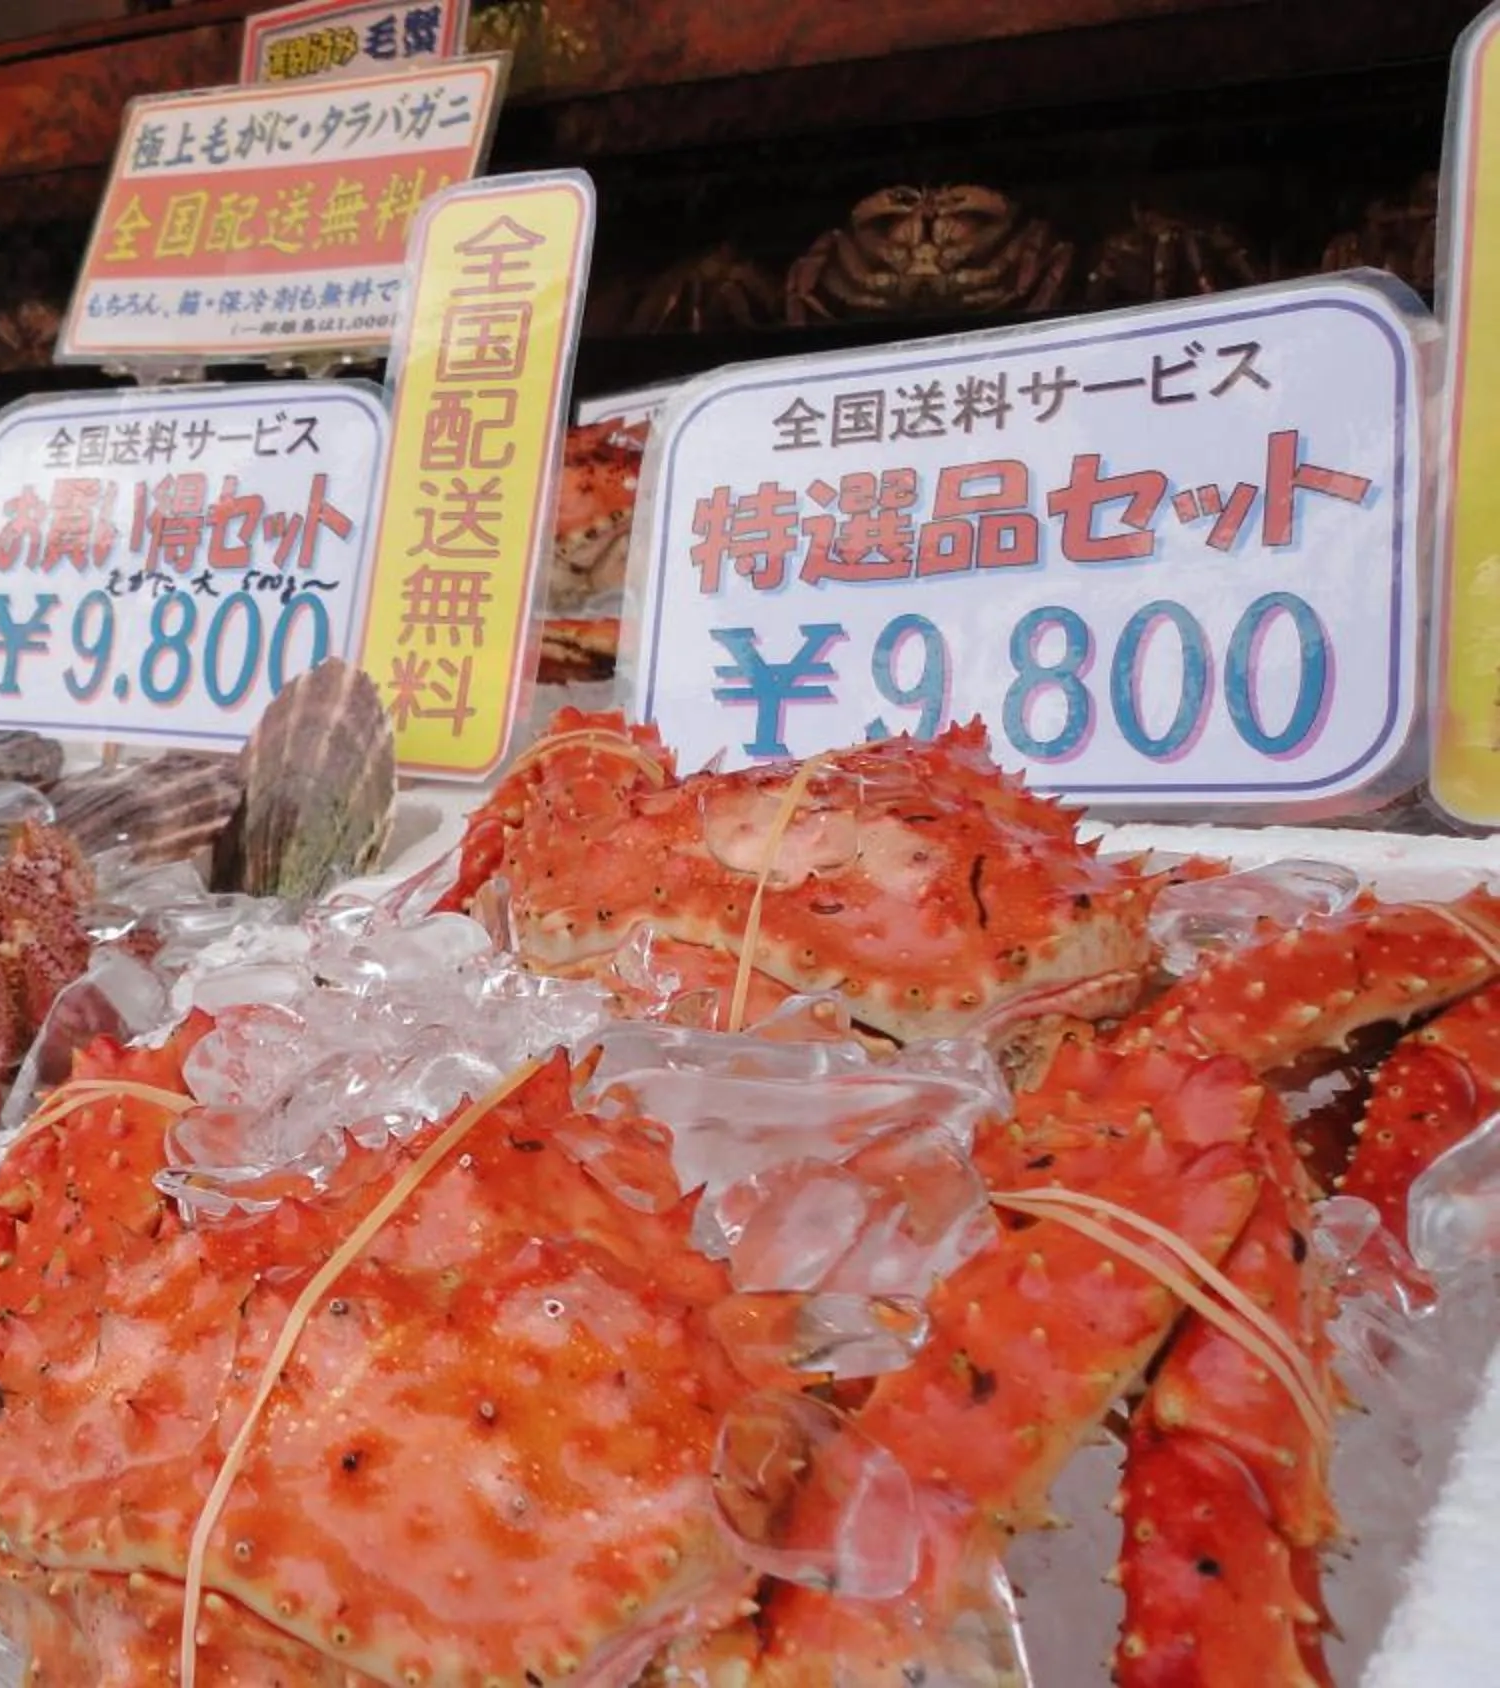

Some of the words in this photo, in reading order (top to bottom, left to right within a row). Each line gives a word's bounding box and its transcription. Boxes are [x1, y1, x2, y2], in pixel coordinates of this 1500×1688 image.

[44, 410, 322, 470] 全国送料サービス
[386, 214, 548, 738] 全国配送無料
[771, 337, 1273, 453] 全国送料サービス
[690, 428, 1376, 595] 特選品セット
[709, 590, 1334, 764] ¥9800
